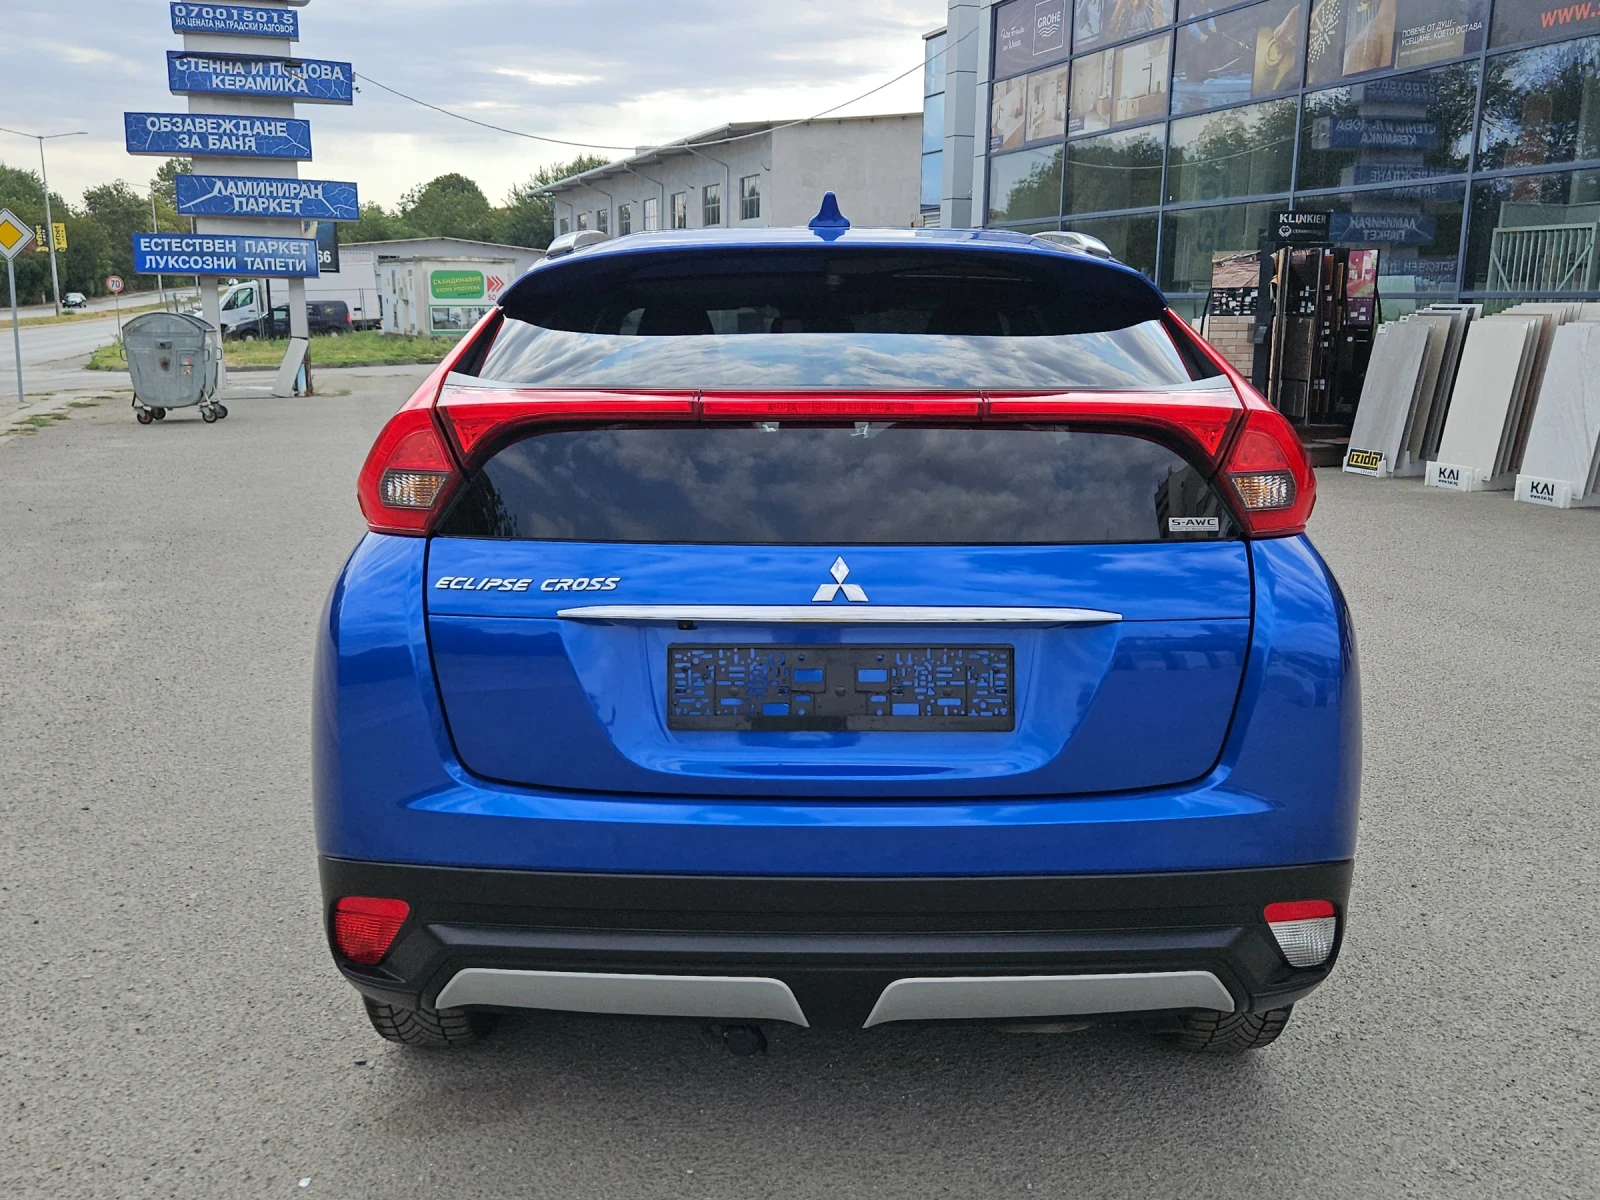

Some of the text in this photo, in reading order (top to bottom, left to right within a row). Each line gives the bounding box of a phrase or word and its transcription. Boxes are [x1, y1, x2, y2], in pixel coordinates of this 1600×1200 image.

[1038, 11, 1061, 28] GROHE
[1541, 2, 1600, 28] www.
[175, 17, 294, 33] НА ЦЕНАТА НА ГРАДСКИ РАЗГОВОР
[1402, 25, 1426, 37] ПОВЕЧЕ
[1427, 23, 1435, 32] ОТ
[1436, 19, 1453, 31] ДУШ
[1434, 28, 1454, 39] КОЕТО
[1455, 22, 1482, 34] ОСТАВА
[175, 58, 246, 74] СТЕННА
[252, 62, 263, 74] И
[212, 75, 309, 93] КЕРАМИКА
[146, 117, 288, 136] ОБЗАВЕЖДАНЕ
[178, 134, 256, 150] ЗА БАНЯ
[213, 180, 323, 199] ЛАМИНИРАН
[234, 197, 303, 213] ПАРКЕТ
[1279, 213, 1327, 224] KLINKIER
[140, 238, 309, 255] ЕСТЕСТВЕН ПАРКЕТ
[145, 256, 307, 271] ЛУКСОЗНИ ТАПЕТИ
[111, 280, 120, 288] 70
[1438, 467, 1459, 480] KAI
[1531, 481, 1554, 496] KAI
[1171, 518, 1216, 526] S-AWC
[434, 576, 621, 592] ECLIPSE CROSS
